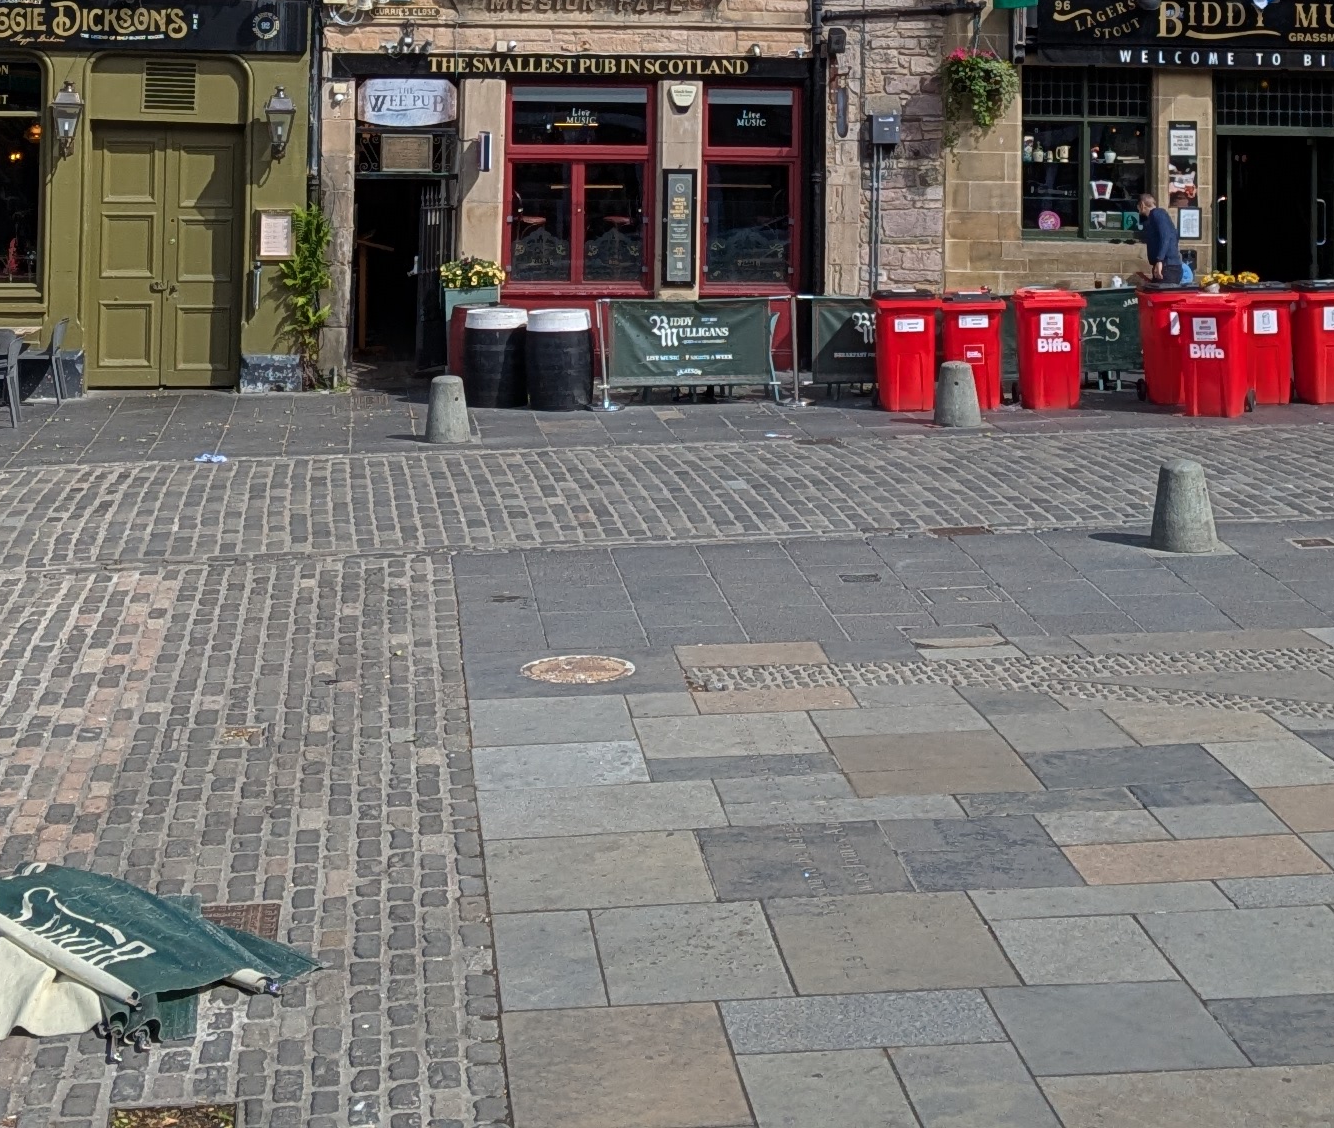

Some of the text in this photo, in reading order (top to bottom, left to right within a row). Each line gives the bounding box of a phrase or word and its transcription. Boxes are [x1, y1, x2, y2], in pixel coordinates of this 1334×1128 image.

[412, 8, 437, 16] CLOSE
[1054, 0, 1071, 11] 96
[50, 0, 188, 39] DICKSON'S
[1156, 1, 1265, 37] BIDDY
[1093, 17, 1141, 39] STOUT
[428, 56, 749, 75] THE SMALLEST PUB IN SCOTLAND
[1119, 49, 1235, 65] WELCOME
[1255, 52, 1281, 65] TO
[368, 94, 446, 113] WEE PUB
[565, 116, 597, 125] MUSIC
[736, 118, 767, 127] MUSIC
[649, 315, 694, 336] BIDDY
[660, 327, 730, 347] MULLIGANS
[1037, 338, 1071, 353] Biffa
[1189, 344, 1225, 359] Biffa
